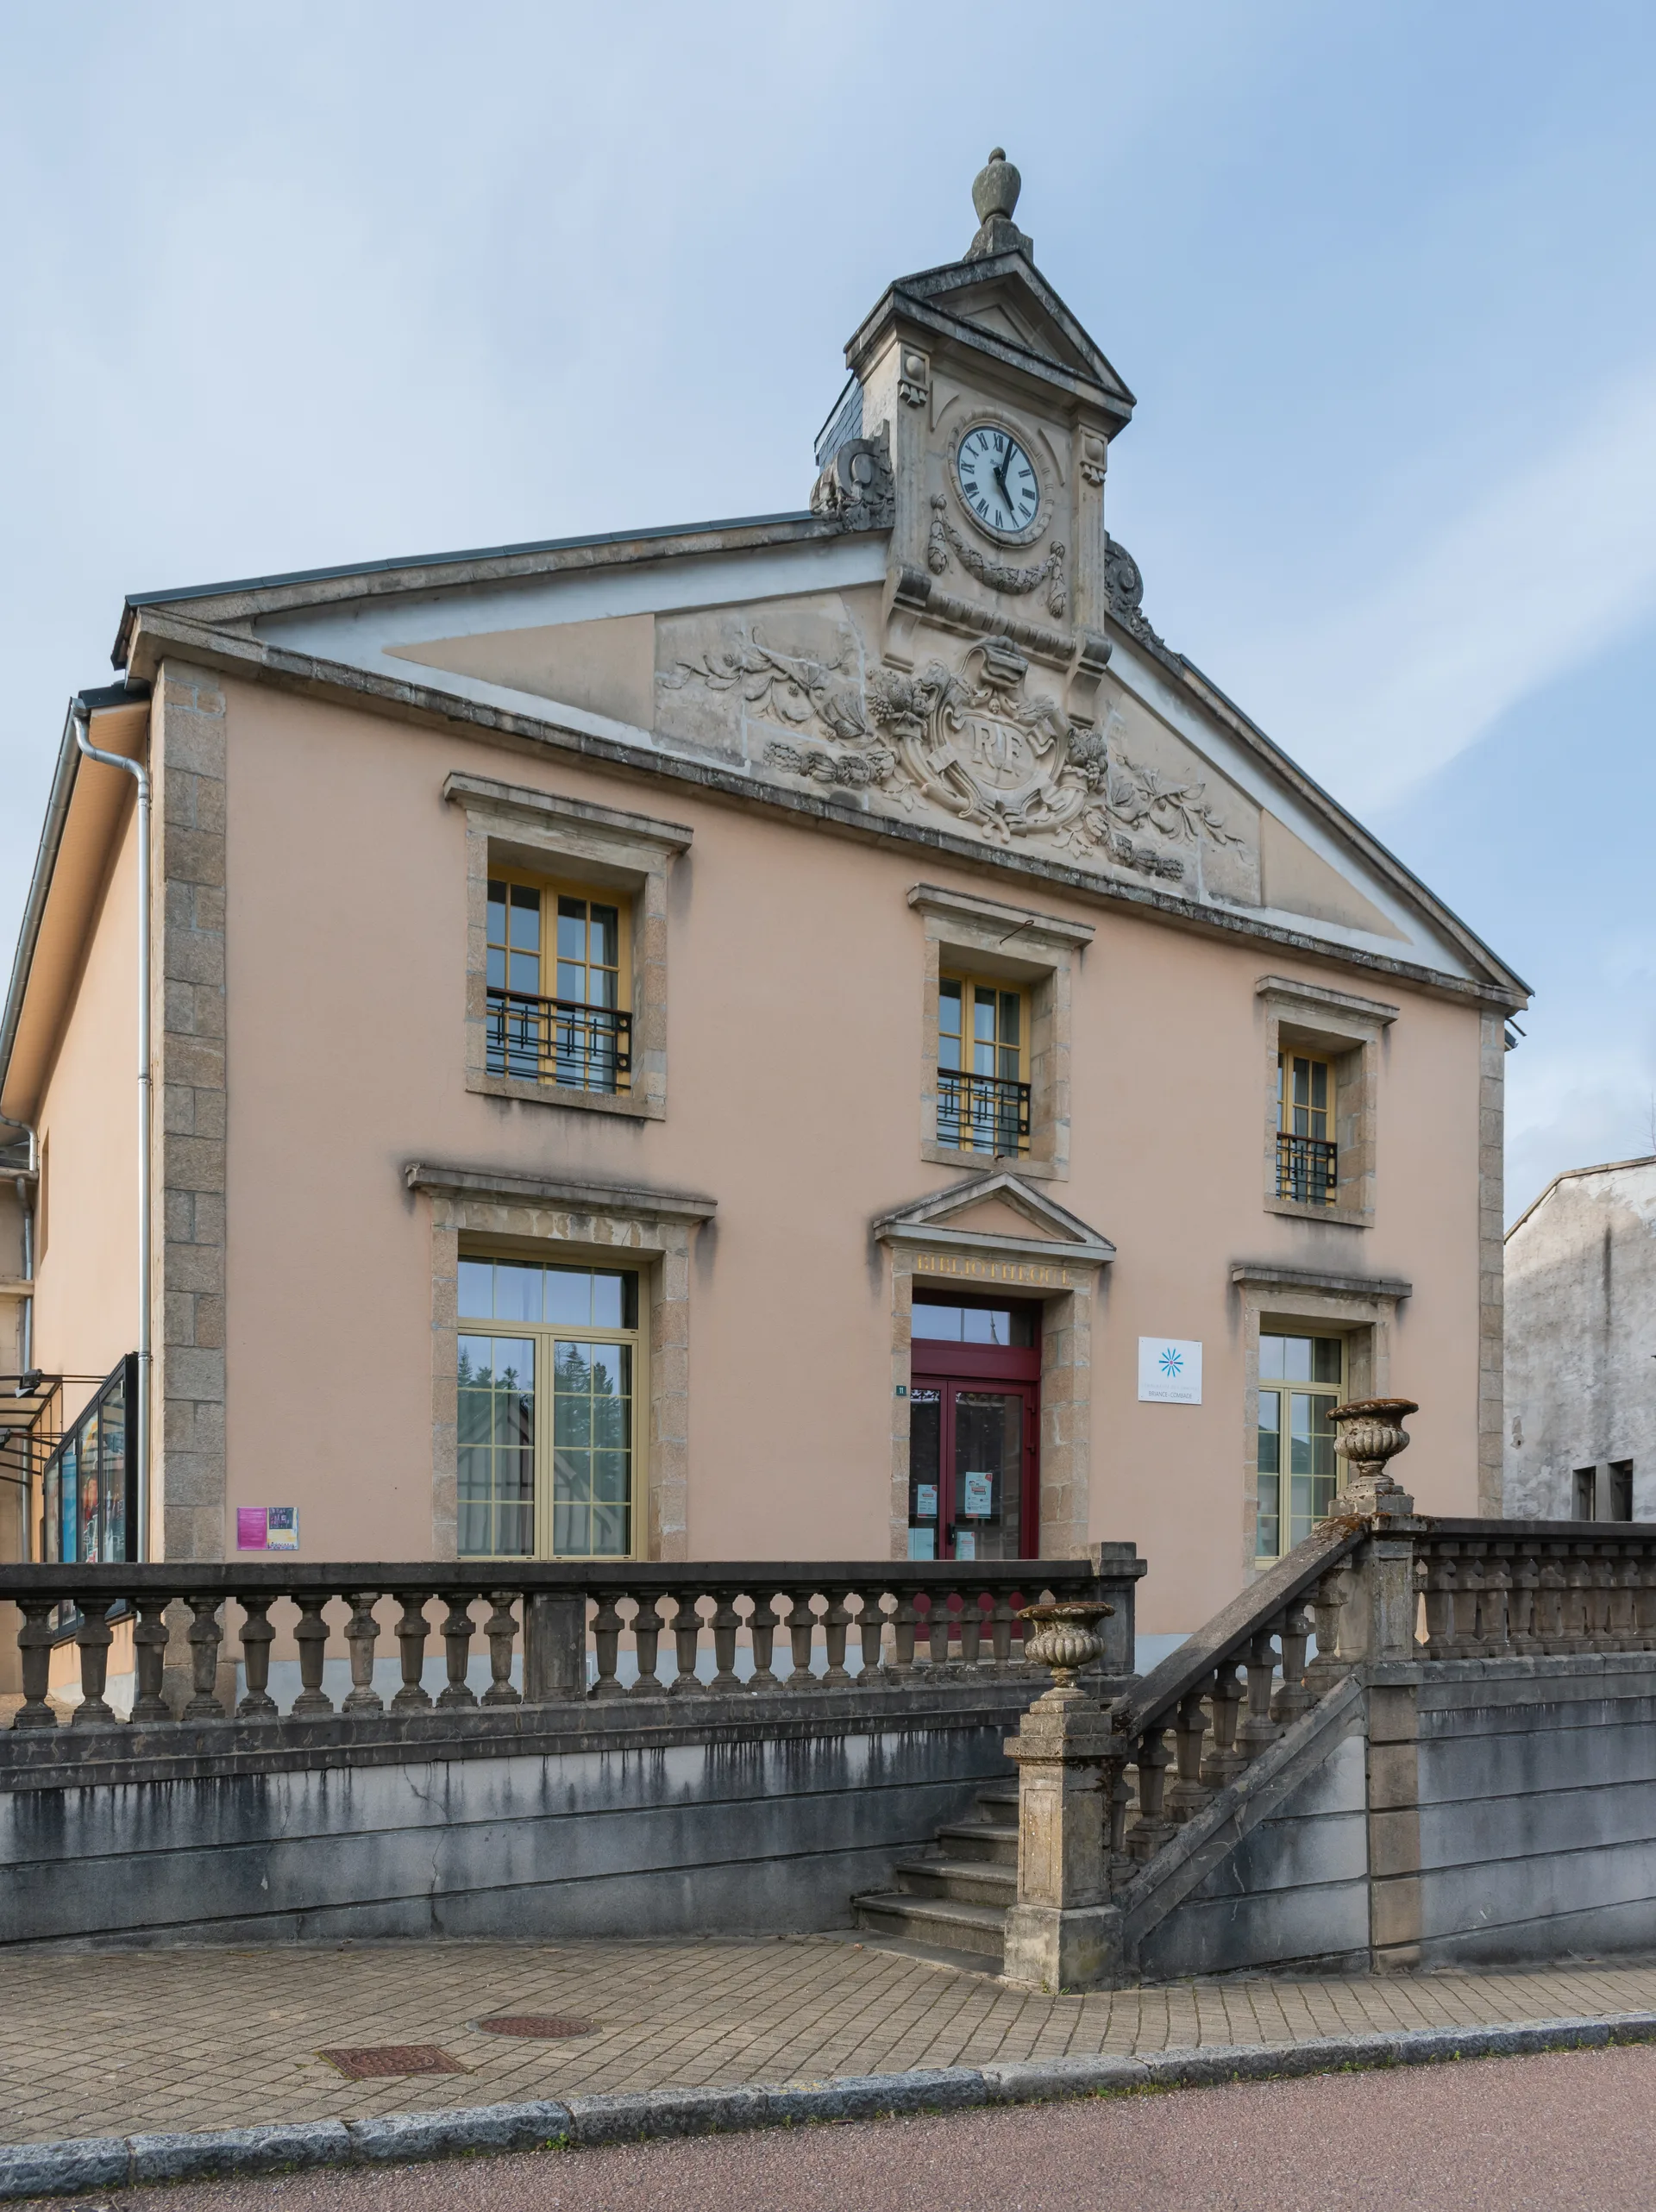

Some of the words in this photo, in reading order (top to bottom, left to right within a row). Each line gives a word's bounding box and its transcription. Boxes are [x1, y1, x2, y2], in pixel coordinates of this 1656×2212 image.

[965, 442, 979, 460] X
[976, 433, 988, 451] XI
[994, 433, 1003, 453] XII
[961, 460, 975, 474] IX
[1018, 469, 1031, 478] II
[976, 498, 989, 518] VII
[995, 510, 1003, 528] VI
